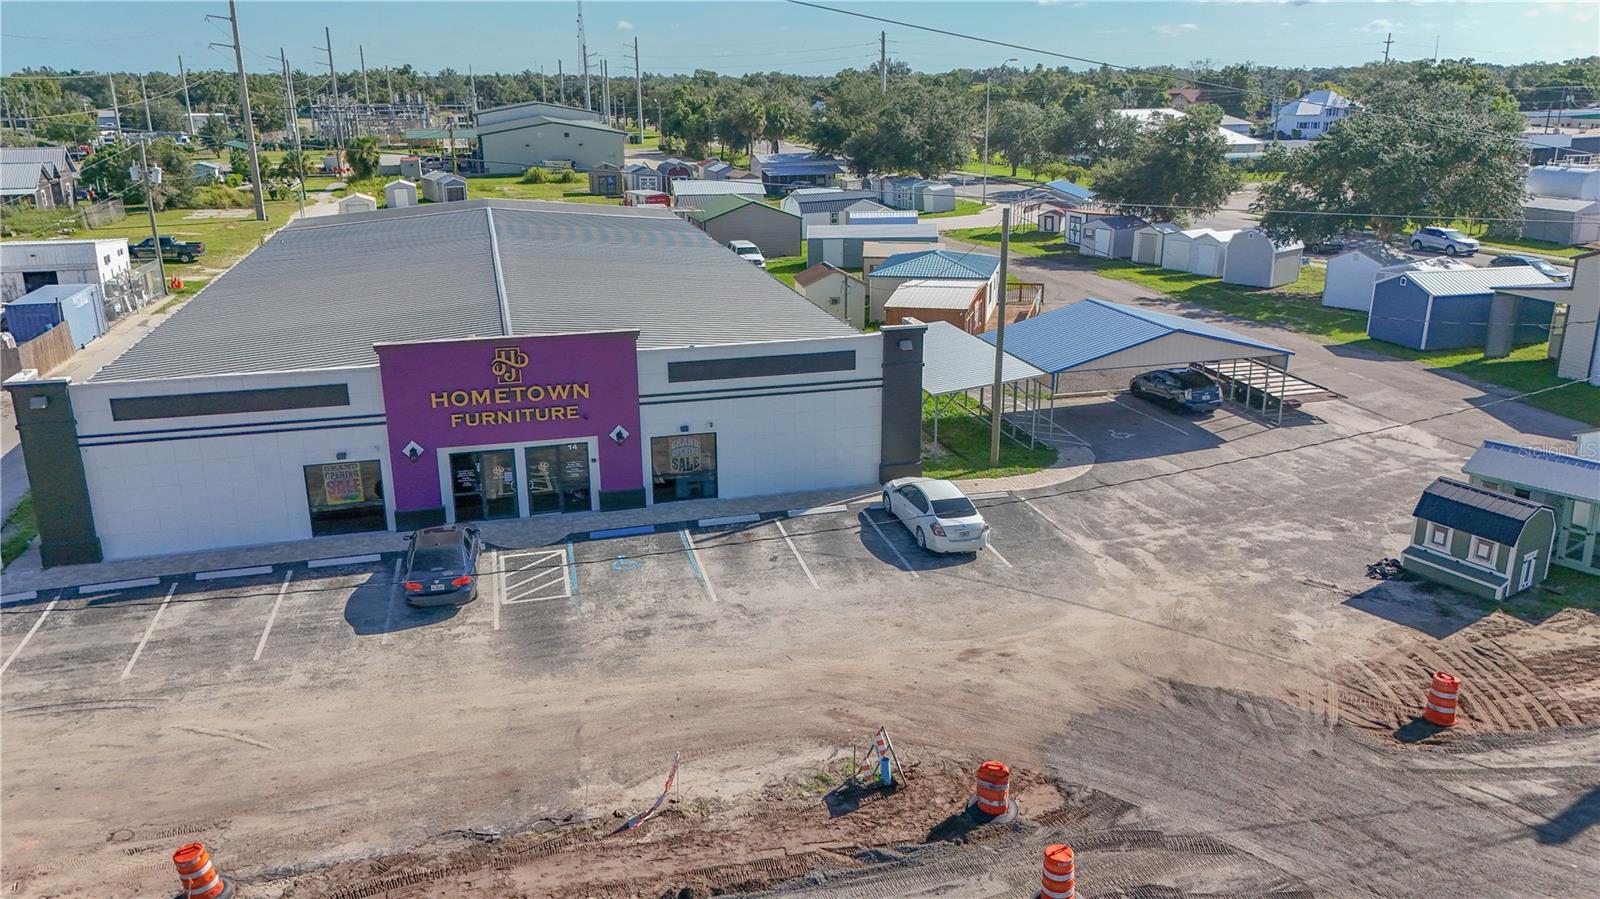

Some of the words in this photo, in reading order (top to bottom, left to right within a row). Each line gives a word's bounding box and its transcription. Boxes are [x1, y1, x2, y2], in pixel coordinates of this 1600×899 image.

[430, 383, 590, 408] HOMETOWN
[450, 405, 580, 428] FURNITURE
[671, 457, 701, 471] SALE
[325, 470, 360, 480] OPENING
